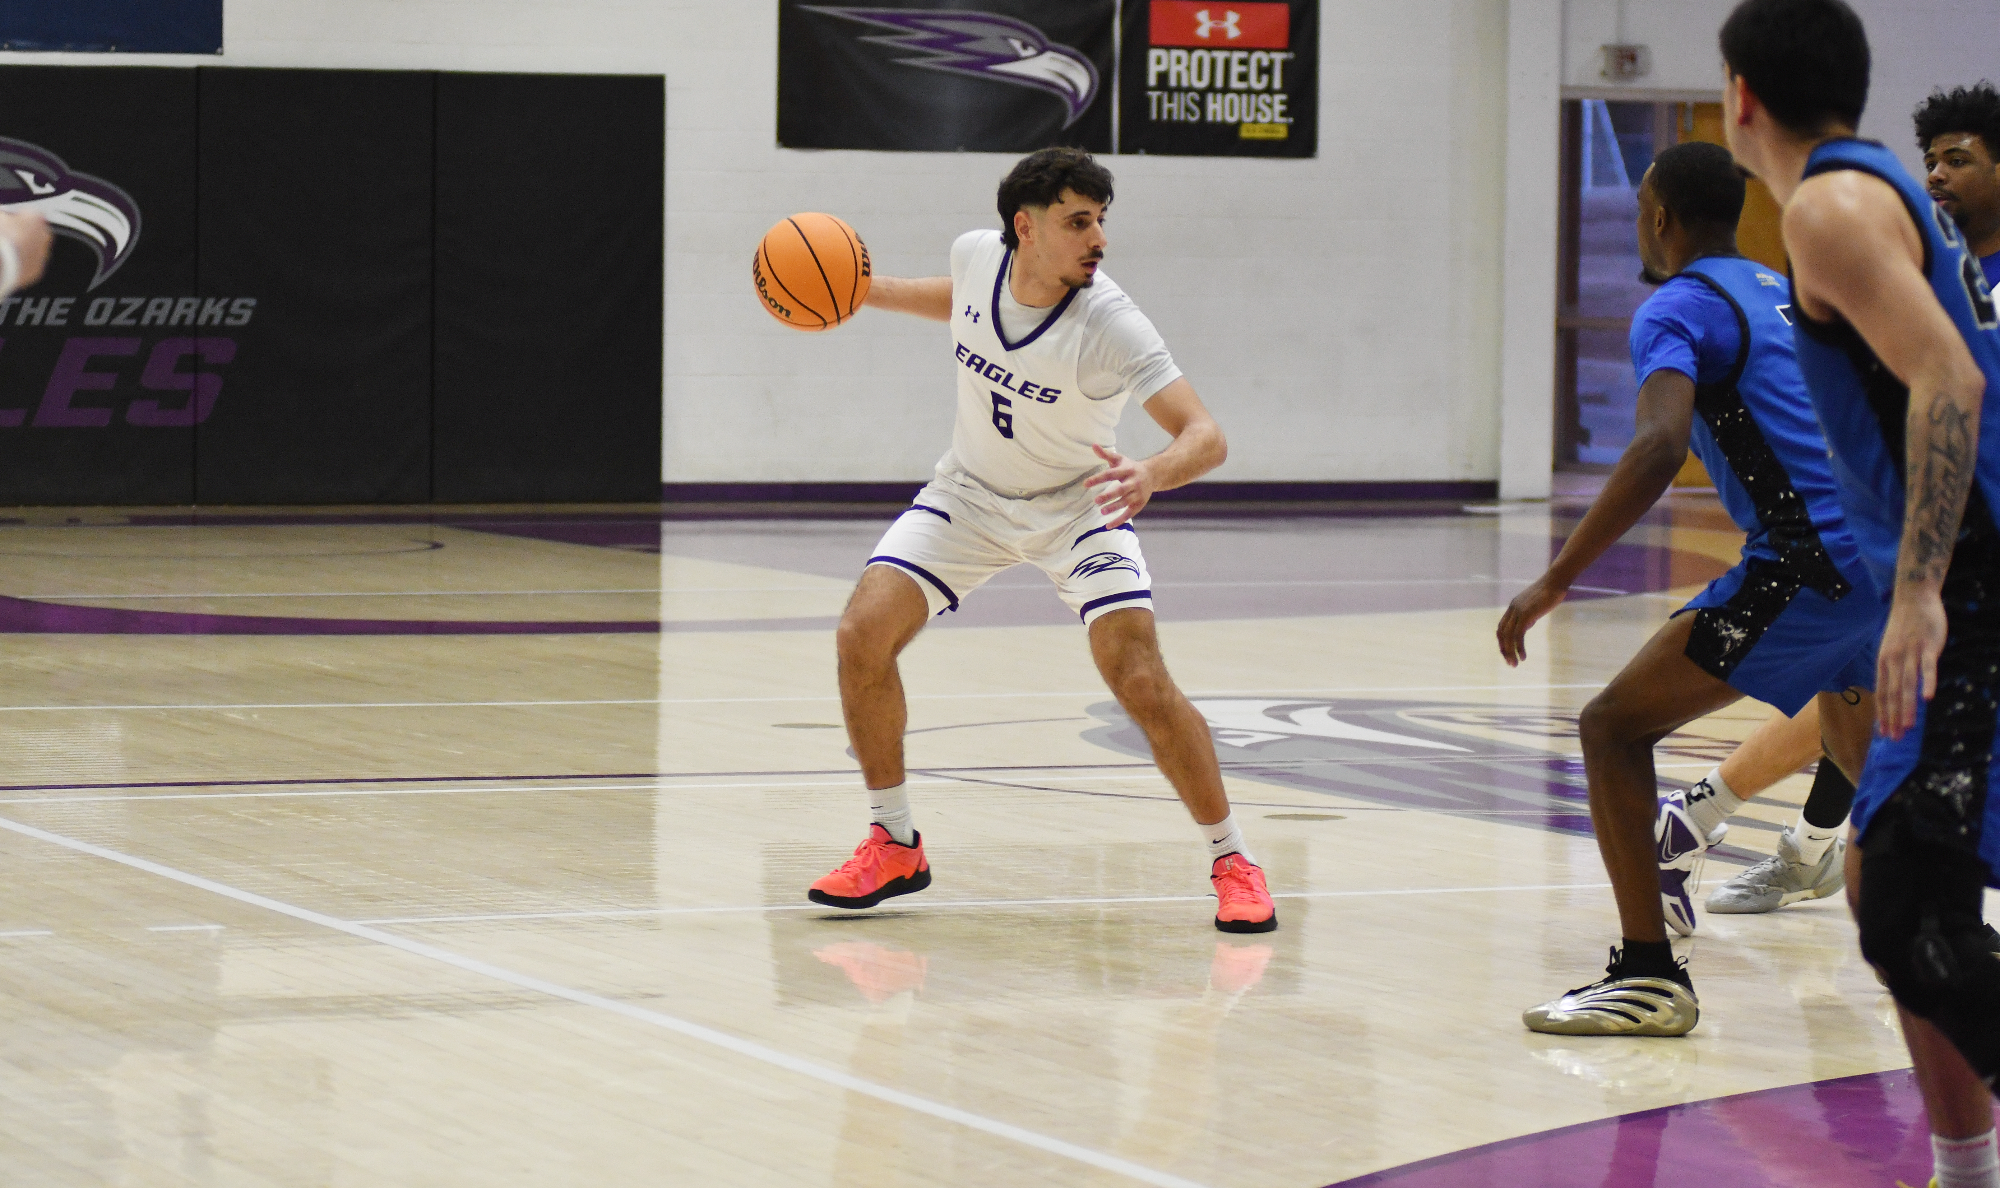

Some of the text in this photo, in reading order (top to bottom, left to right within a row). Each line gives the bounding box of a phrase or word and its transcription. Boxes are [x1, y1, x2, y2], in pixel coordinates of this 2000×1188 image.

[1148, 48, 1289, 91] PROTECT
[1148, 91, 1201, 122] THIS
[83, 297, 257, 326] OZARKS
[956, 341, 1062, 404] EAGLES
[990, 389, 1013, 439] 6
